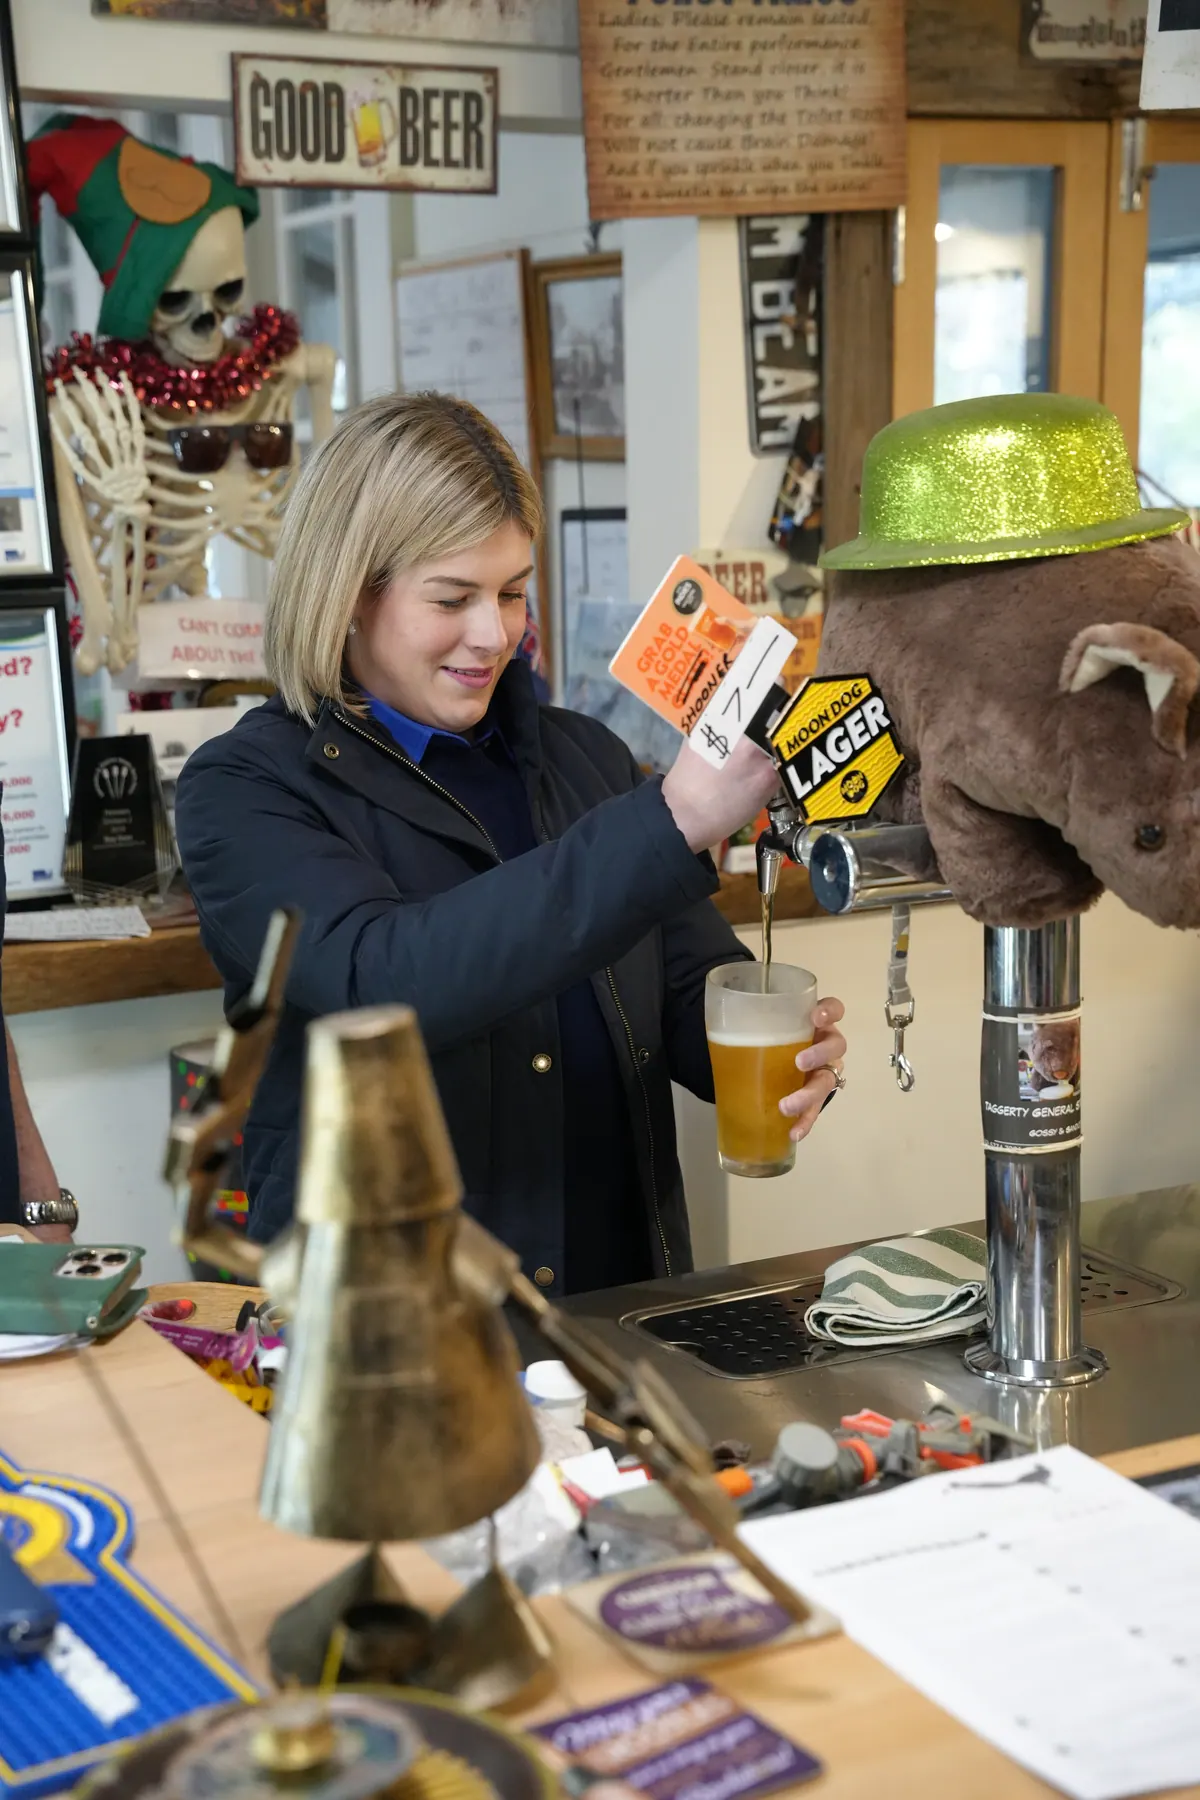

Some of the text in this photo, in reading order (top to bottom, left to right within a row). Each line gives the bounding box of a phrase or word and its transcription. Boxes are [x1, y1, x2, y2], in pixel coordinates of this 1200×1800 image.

[672, 11, 729, 27] Please
[612, 36, 643, 52] For
[651, 36, 678, 51] the
[687, 35, 742, 51] Entire
[710, 60, 762, 77] Stand
[622, 88, 693, 104] Shorter
[702, 86, 745, 101] Than
[752, 90, 784, 106] you
[250, 76, 485, 170] GOOD BEER
[602, 114, 635, 130] For
[673, 110, 751, 130] changing
[759, 109, 787, 126] the
[797, 108, 844, 124] Toilet
[646, 137, 676, 152] not
[683, 136, 734, 151] cause
[740, 134, 789, 151] Brain
[605, 161, 640, 177] And
[698, 562, 769, 604] EER
[171, 645, 225, 663] ABOUT
[637, 623, 672, 673] GRAB
[0, 656, 32, 677] ed?
[646, 626, 689, 692] A GOLD
[658, 640, 703, 700] MEDAL
[786, 710, 829, 753] MOON
[831, 683, 863, 716] DOG
[786, 697, 891, 800] LAGER
[984, 1101, 1029, 1117] TAGGERTY
[1032, 1104, 1075, 1117] GENERAL
[1029, 1128, 1058, 1137] GOSSY
[1058, 1127, 1065, 1135] &
